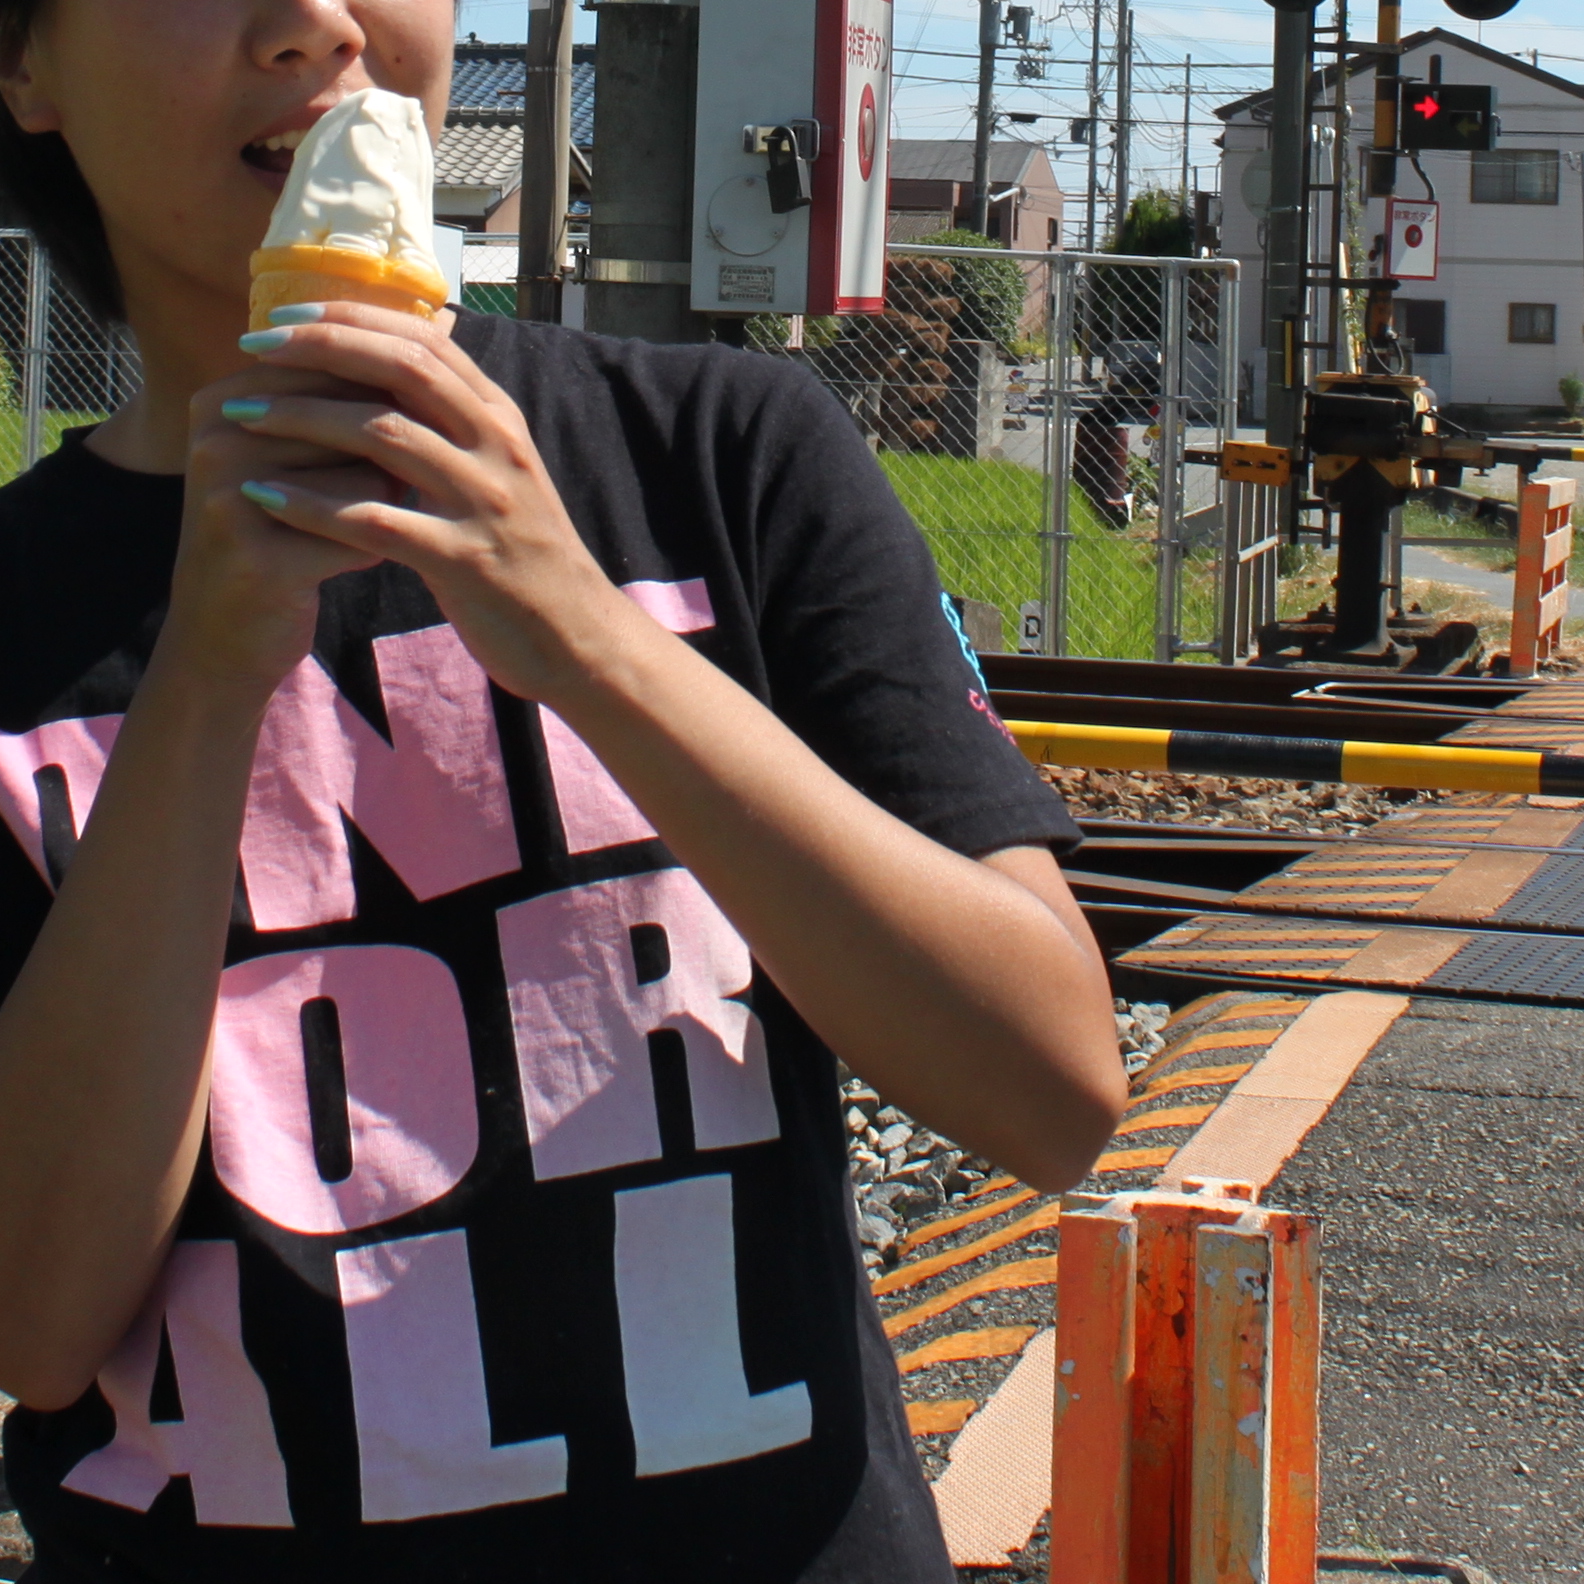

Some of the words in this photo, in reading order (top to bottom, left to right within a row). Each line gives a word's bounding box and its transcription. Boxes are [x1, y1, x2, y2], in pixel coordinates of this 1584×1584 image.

[848, 21, 890, 73] 非常ボタン
